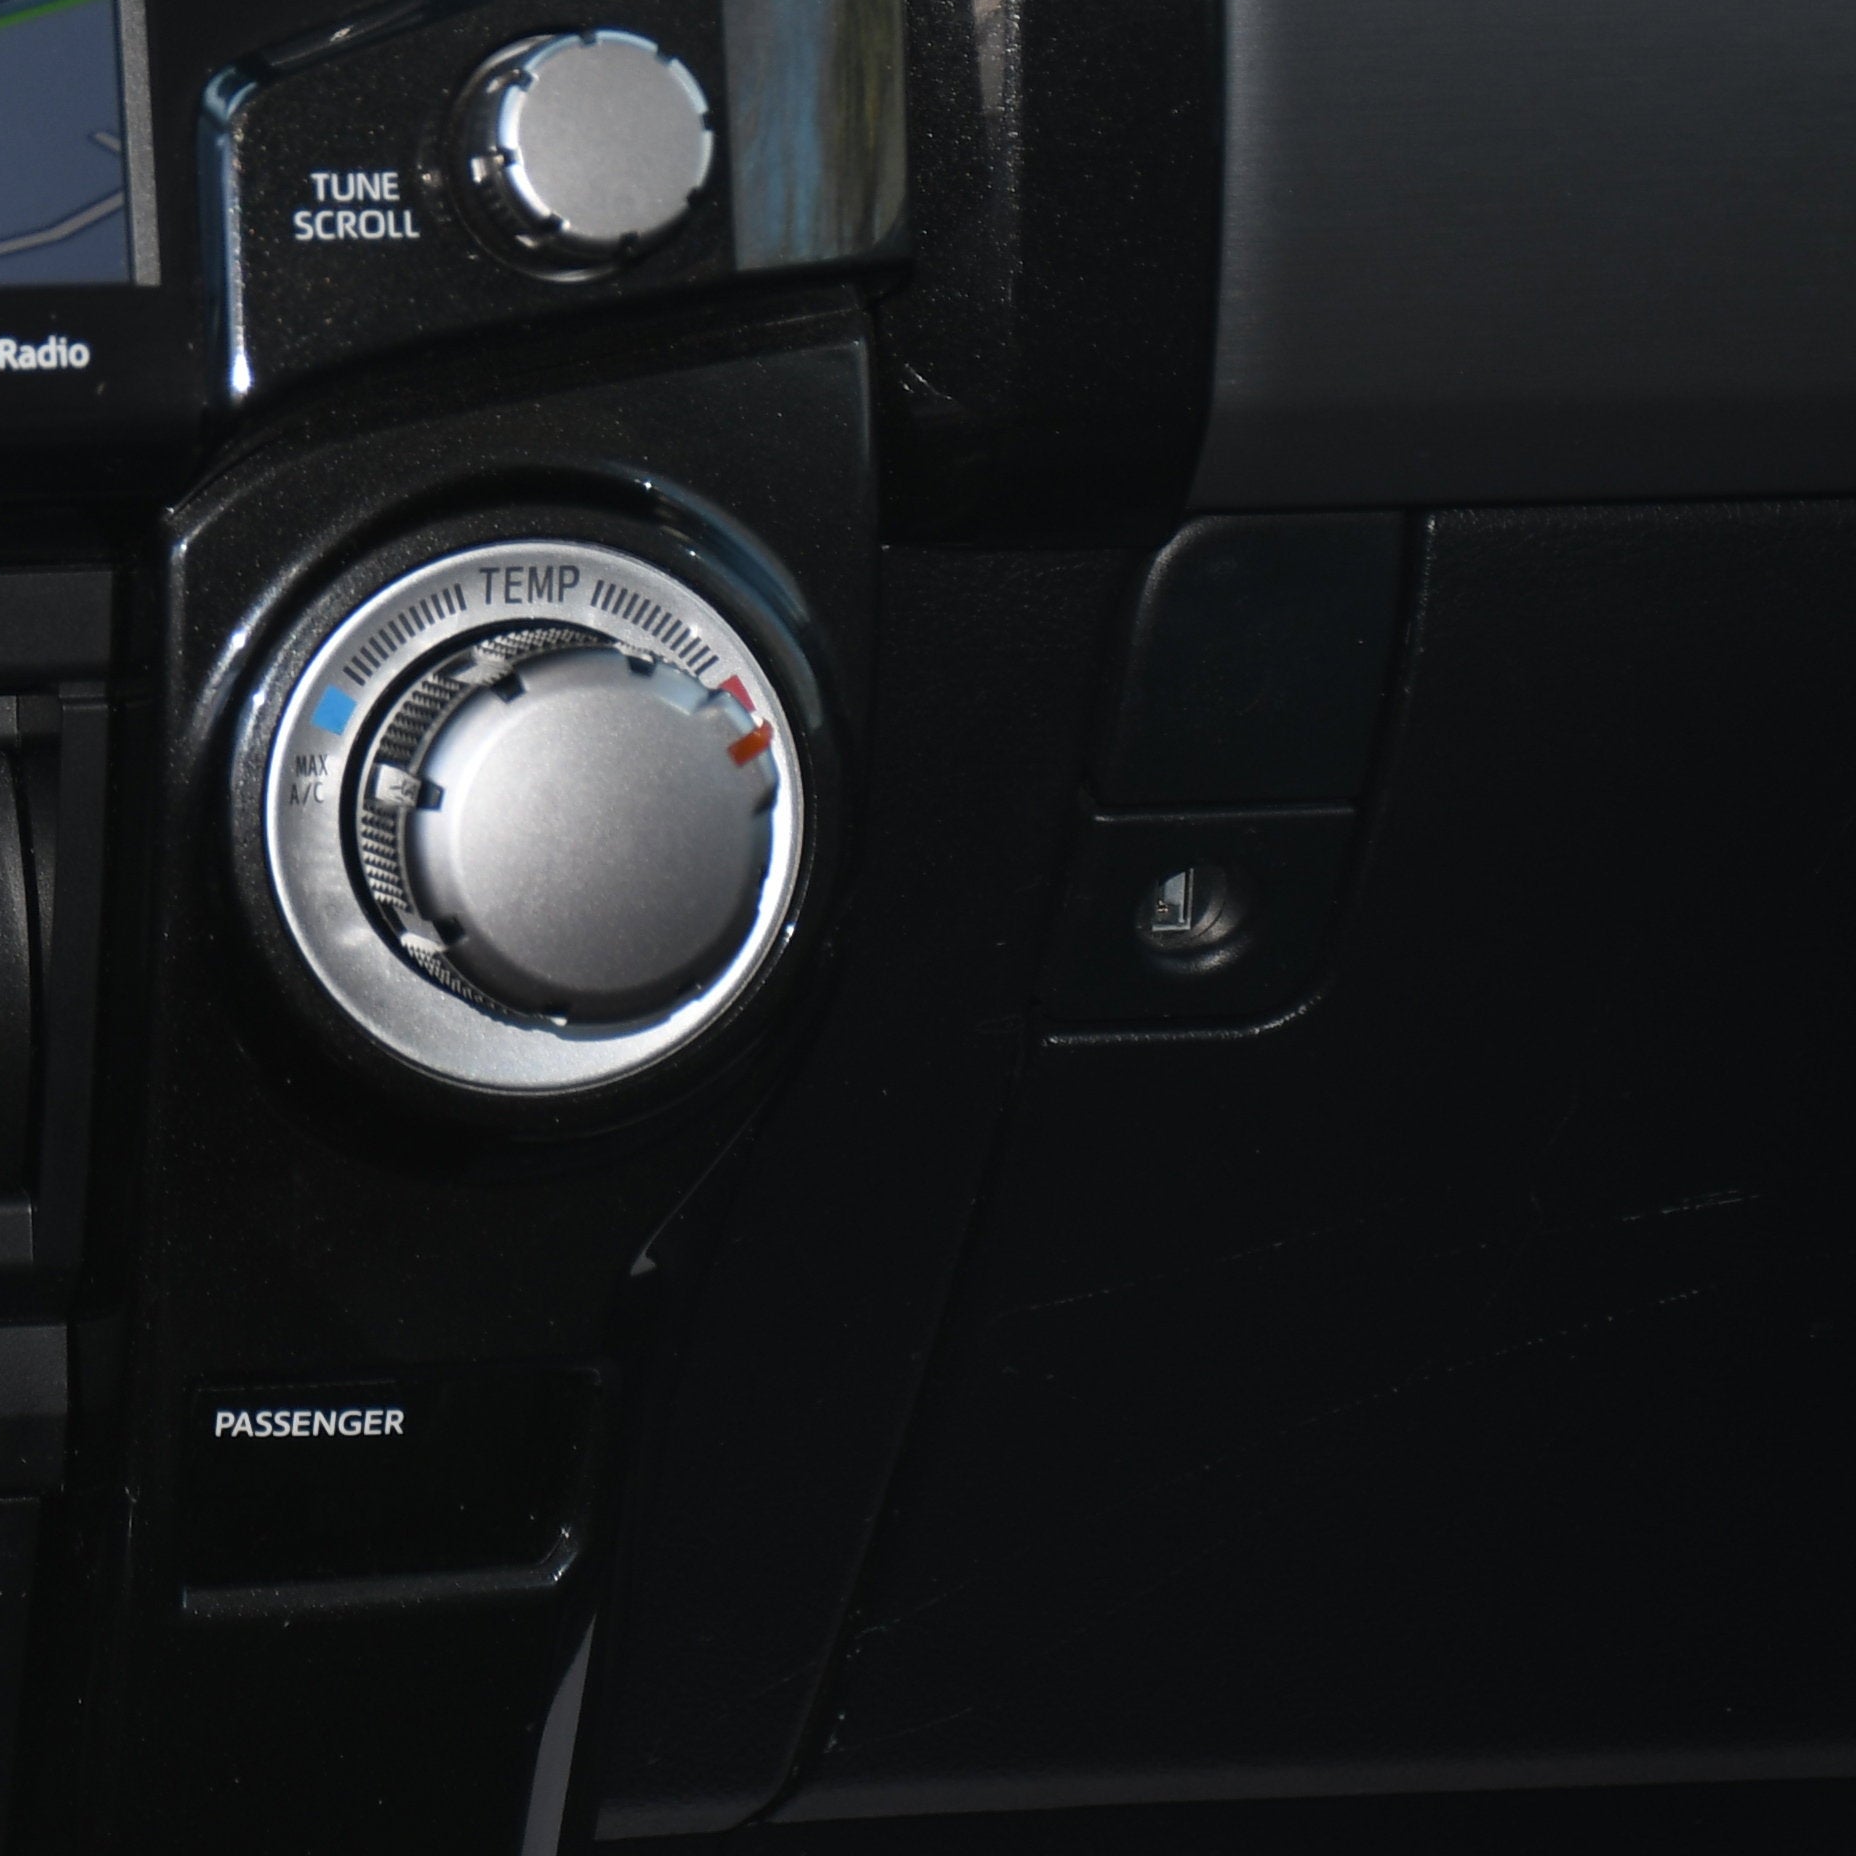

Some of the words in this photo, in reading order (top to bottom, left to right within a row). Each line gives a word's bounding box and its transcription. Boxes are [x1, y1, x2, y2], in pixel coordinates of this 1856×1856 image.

[309, 170, 400, 203] TUNE
[293, 206, 420, 243] SCROLL
[479, 564, 582, 607] TEMP
[295, 753, 330, 778] MAX
[288, 782, 325, 808] A/C
[214, 1408, 405, 1438] PASSENGER
